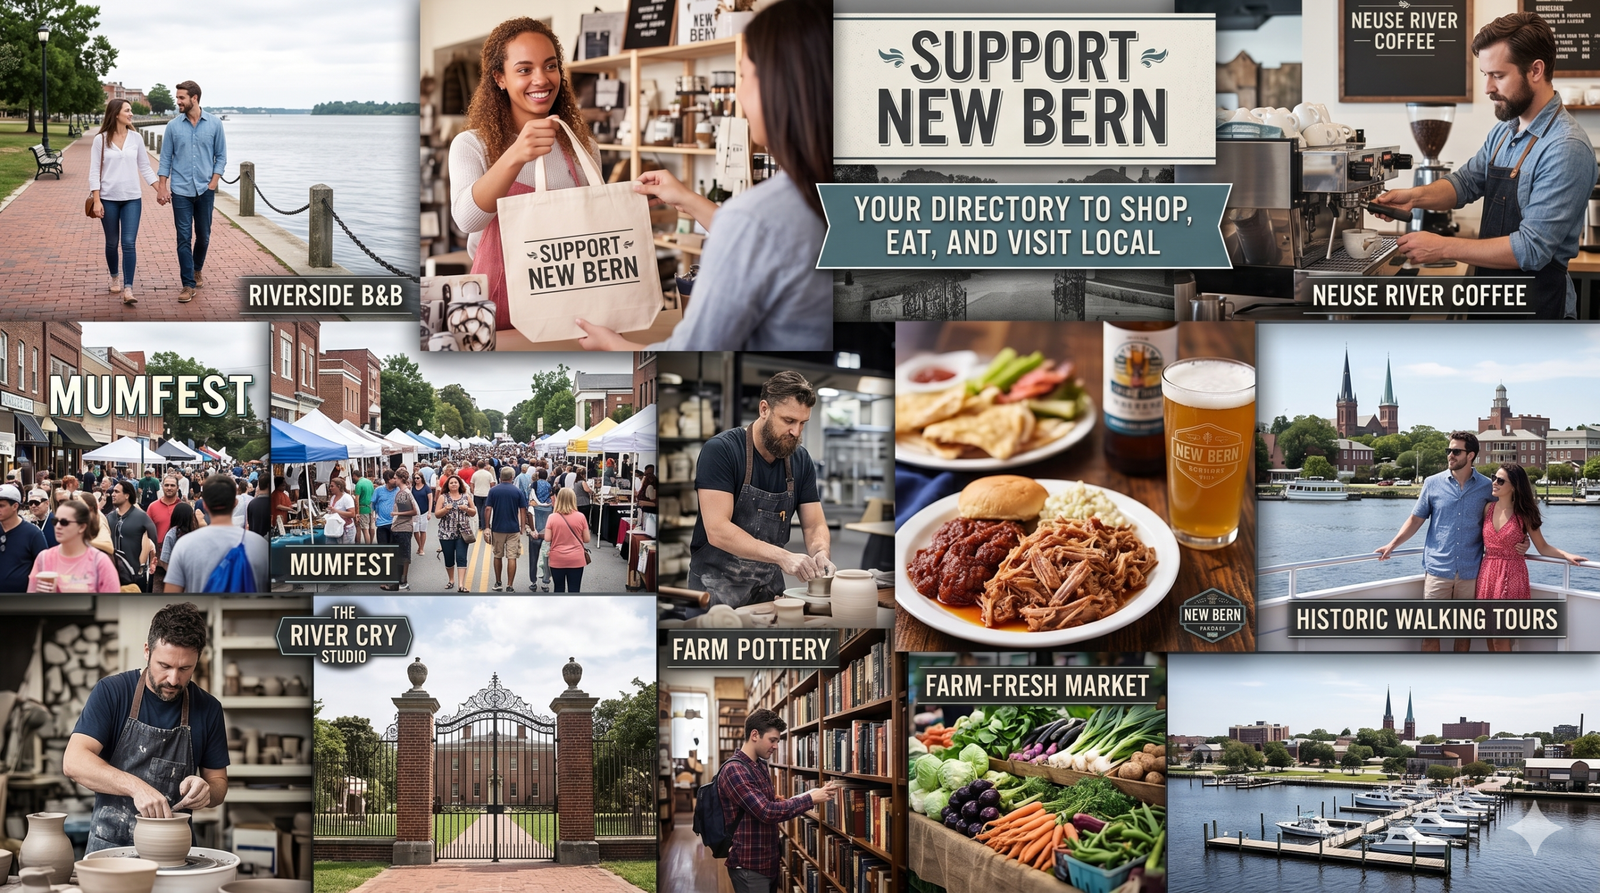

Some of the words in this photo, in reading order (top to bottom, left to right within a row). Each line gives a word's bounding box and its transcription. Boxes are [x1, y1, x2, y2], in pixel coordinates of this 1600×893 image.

[693, 13, 713, 27] NEW
[1351, 11, 1405, 29] NEUSE
[1410, 11, 1458, 29] RIVER
[1374, 32, 1436, 50] COFFEE
[540, 235, 620, 263] SUPPORT
[528, 263, 575, 290] NEW
[583, 256, 639, 283] BERN
[1176, 442, 1203, 462] NEW
[1207, 446, 1239, 463] BERN
